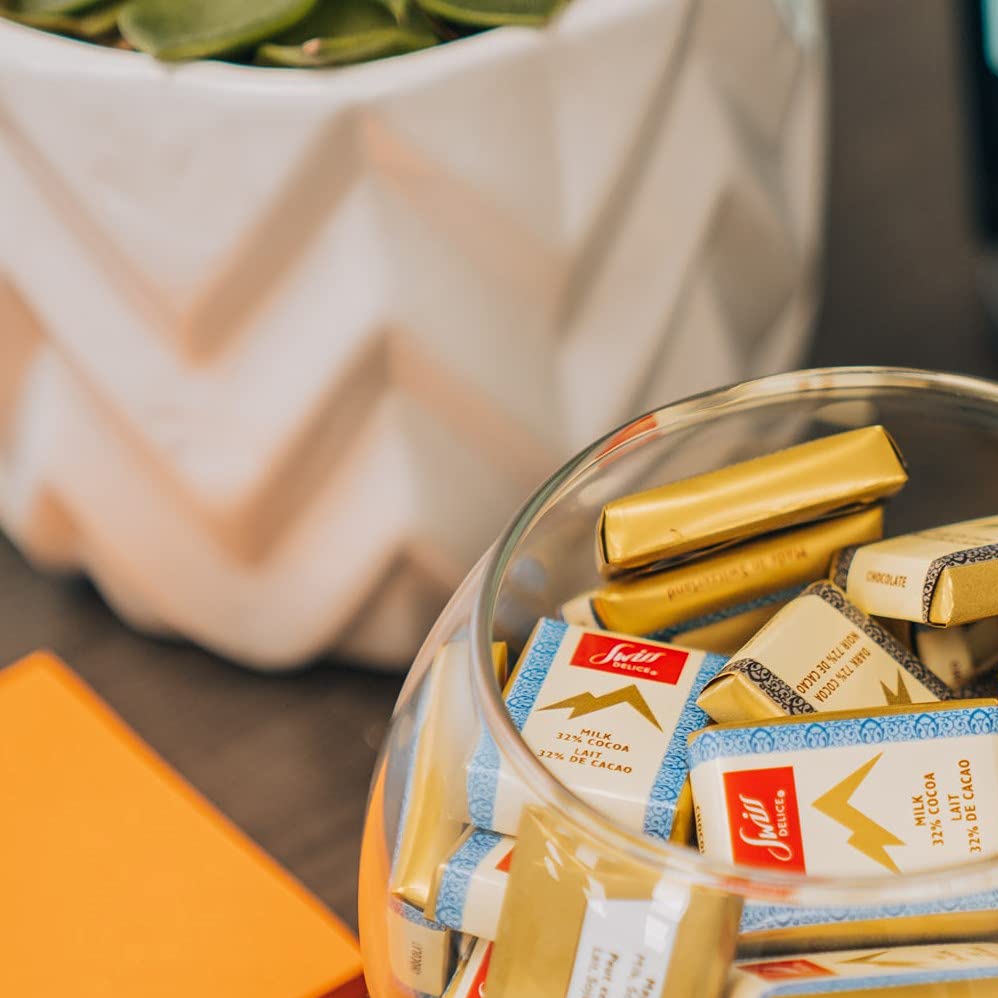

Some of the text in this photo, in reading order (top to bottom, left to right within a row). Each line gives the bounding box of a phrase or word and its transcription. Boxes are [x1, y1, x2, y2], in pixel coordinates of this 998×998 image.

[865, 570, 908, 588] CHOCOLATE
[589, 643, 667, 665] Swiss
[796, 631, 861, 694] NOIR 72% DE CACAO
[813, 647, 871, 703] DARK 72% COCOA
[556, 732, 630, 753] 32% COCOA
[580, 728, 612, 741] MILK
[538, 749, 632, 774] 32% DE CACAO
[574, 748, 602, 759] LAIT
[775, 798, 788, 837] DELICE
[912, 795, 926, 826] MILK
[923, 772, 945, 847] 32% COCOA
[948, 794, 962, 821] LAIT
[958, 759, 981, 853] 32% DE CACAO
[739, 793, 792, 861] Swiss
